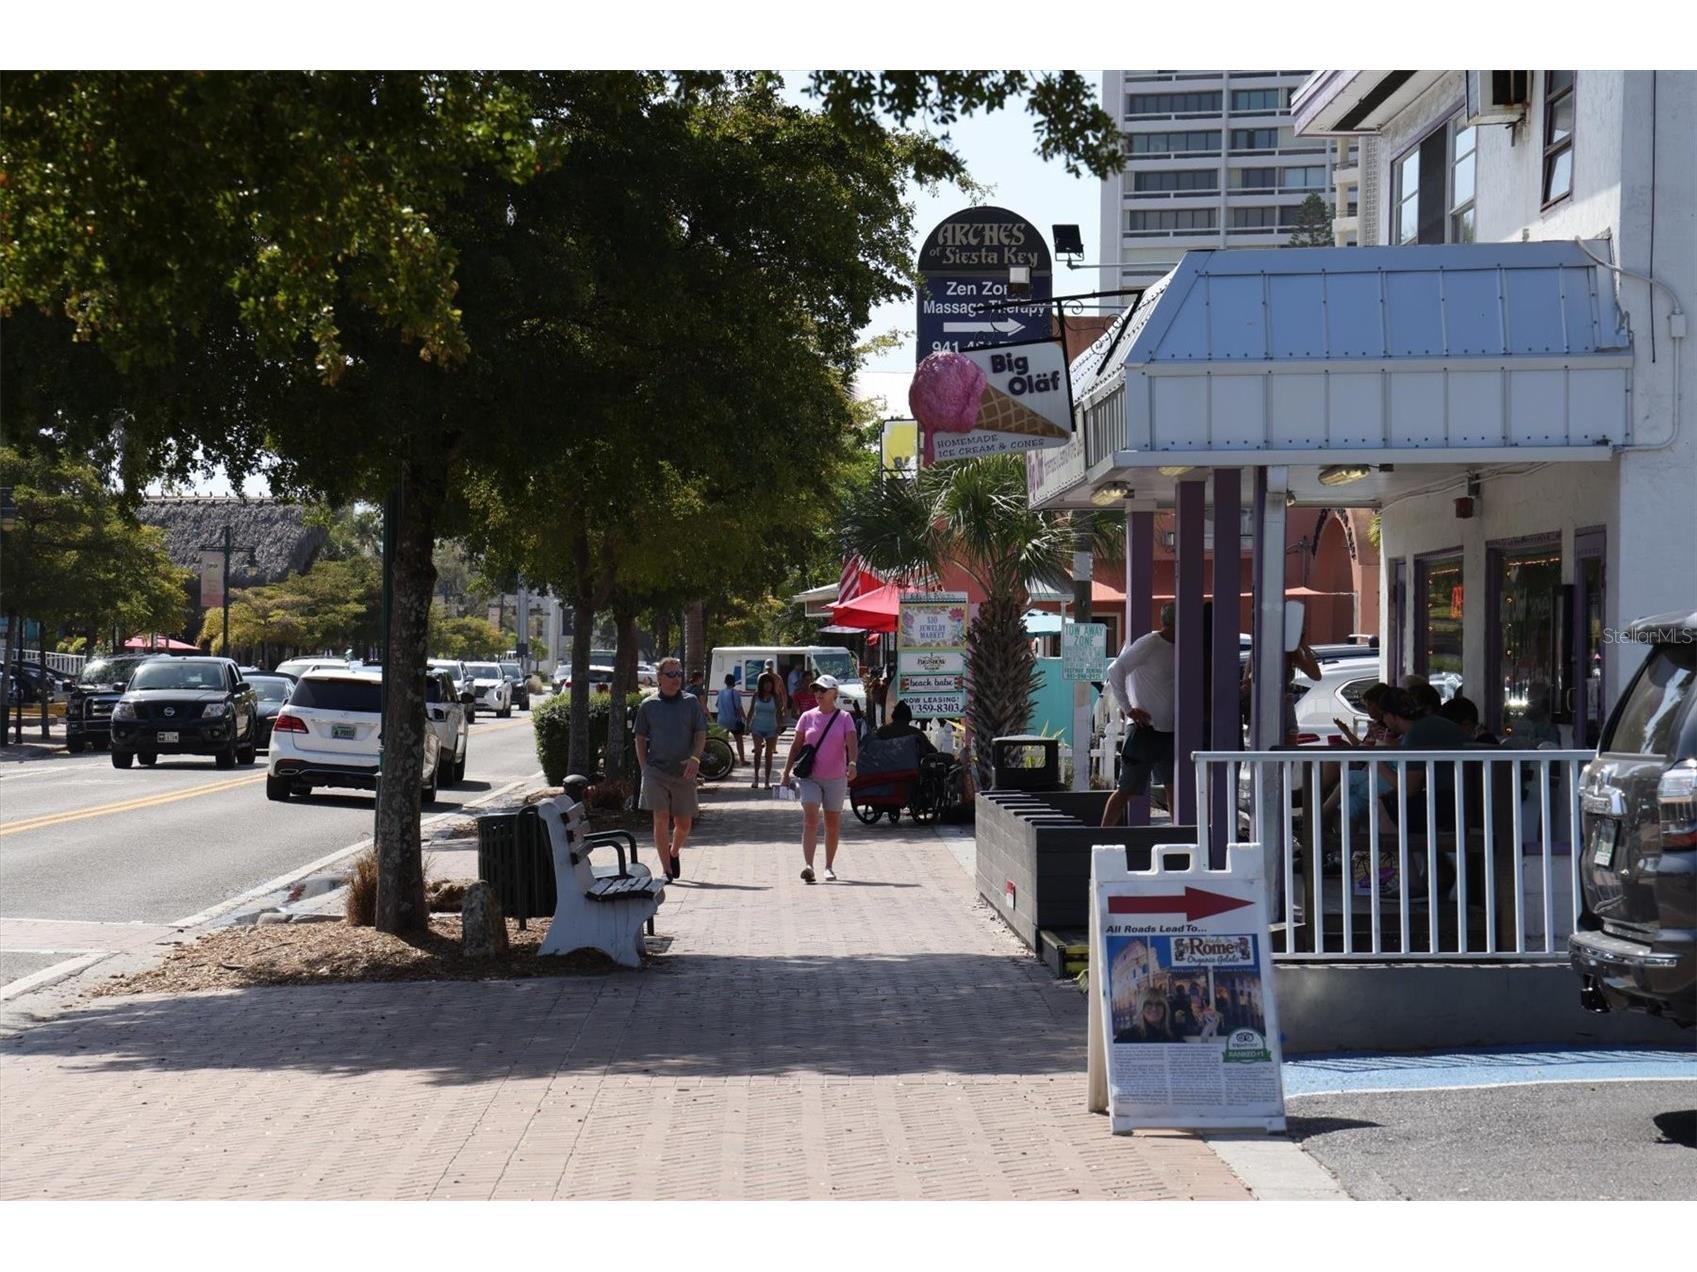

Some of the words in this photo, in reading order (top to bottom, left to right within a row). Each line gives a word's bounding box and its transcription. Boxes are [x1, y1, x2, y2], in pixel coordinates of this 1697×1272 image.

[937, 223, 1026, 246] ARCHES
[929, 247, 942, 257] of
[942, 247, 998, 264] Siesta
[1004, 247, 1038, 267] Key
[946, 281, 977, 296] Zen
[923, 300, 984, 317] Massage
[991, 352, 1029, 375] Big
[1008, 370, 1060, 396] Oläf
[937, 434, 999, 449] HOMEMADE
[938, 449, 956, 458] ICE
[958, 444, 996, 455] CREAM
[999, 442, 1007, 451] &
[1010, 439, 1045, 449] CONES
[1064, 625, 1080, 636] TOW
[1084, 625, 1104, 636] AWAY
[1074, 636, 1094, 647] ZONE
[910, 678, 932, 687] beach
[934, 678, 954, 687] babe
[1105, 925, 1121, 933] All
[1124, 925, 1156, 933] Roads
[1160, 925, 1184, 933] Lead
[1190, 937, 1234, 956] Rome
